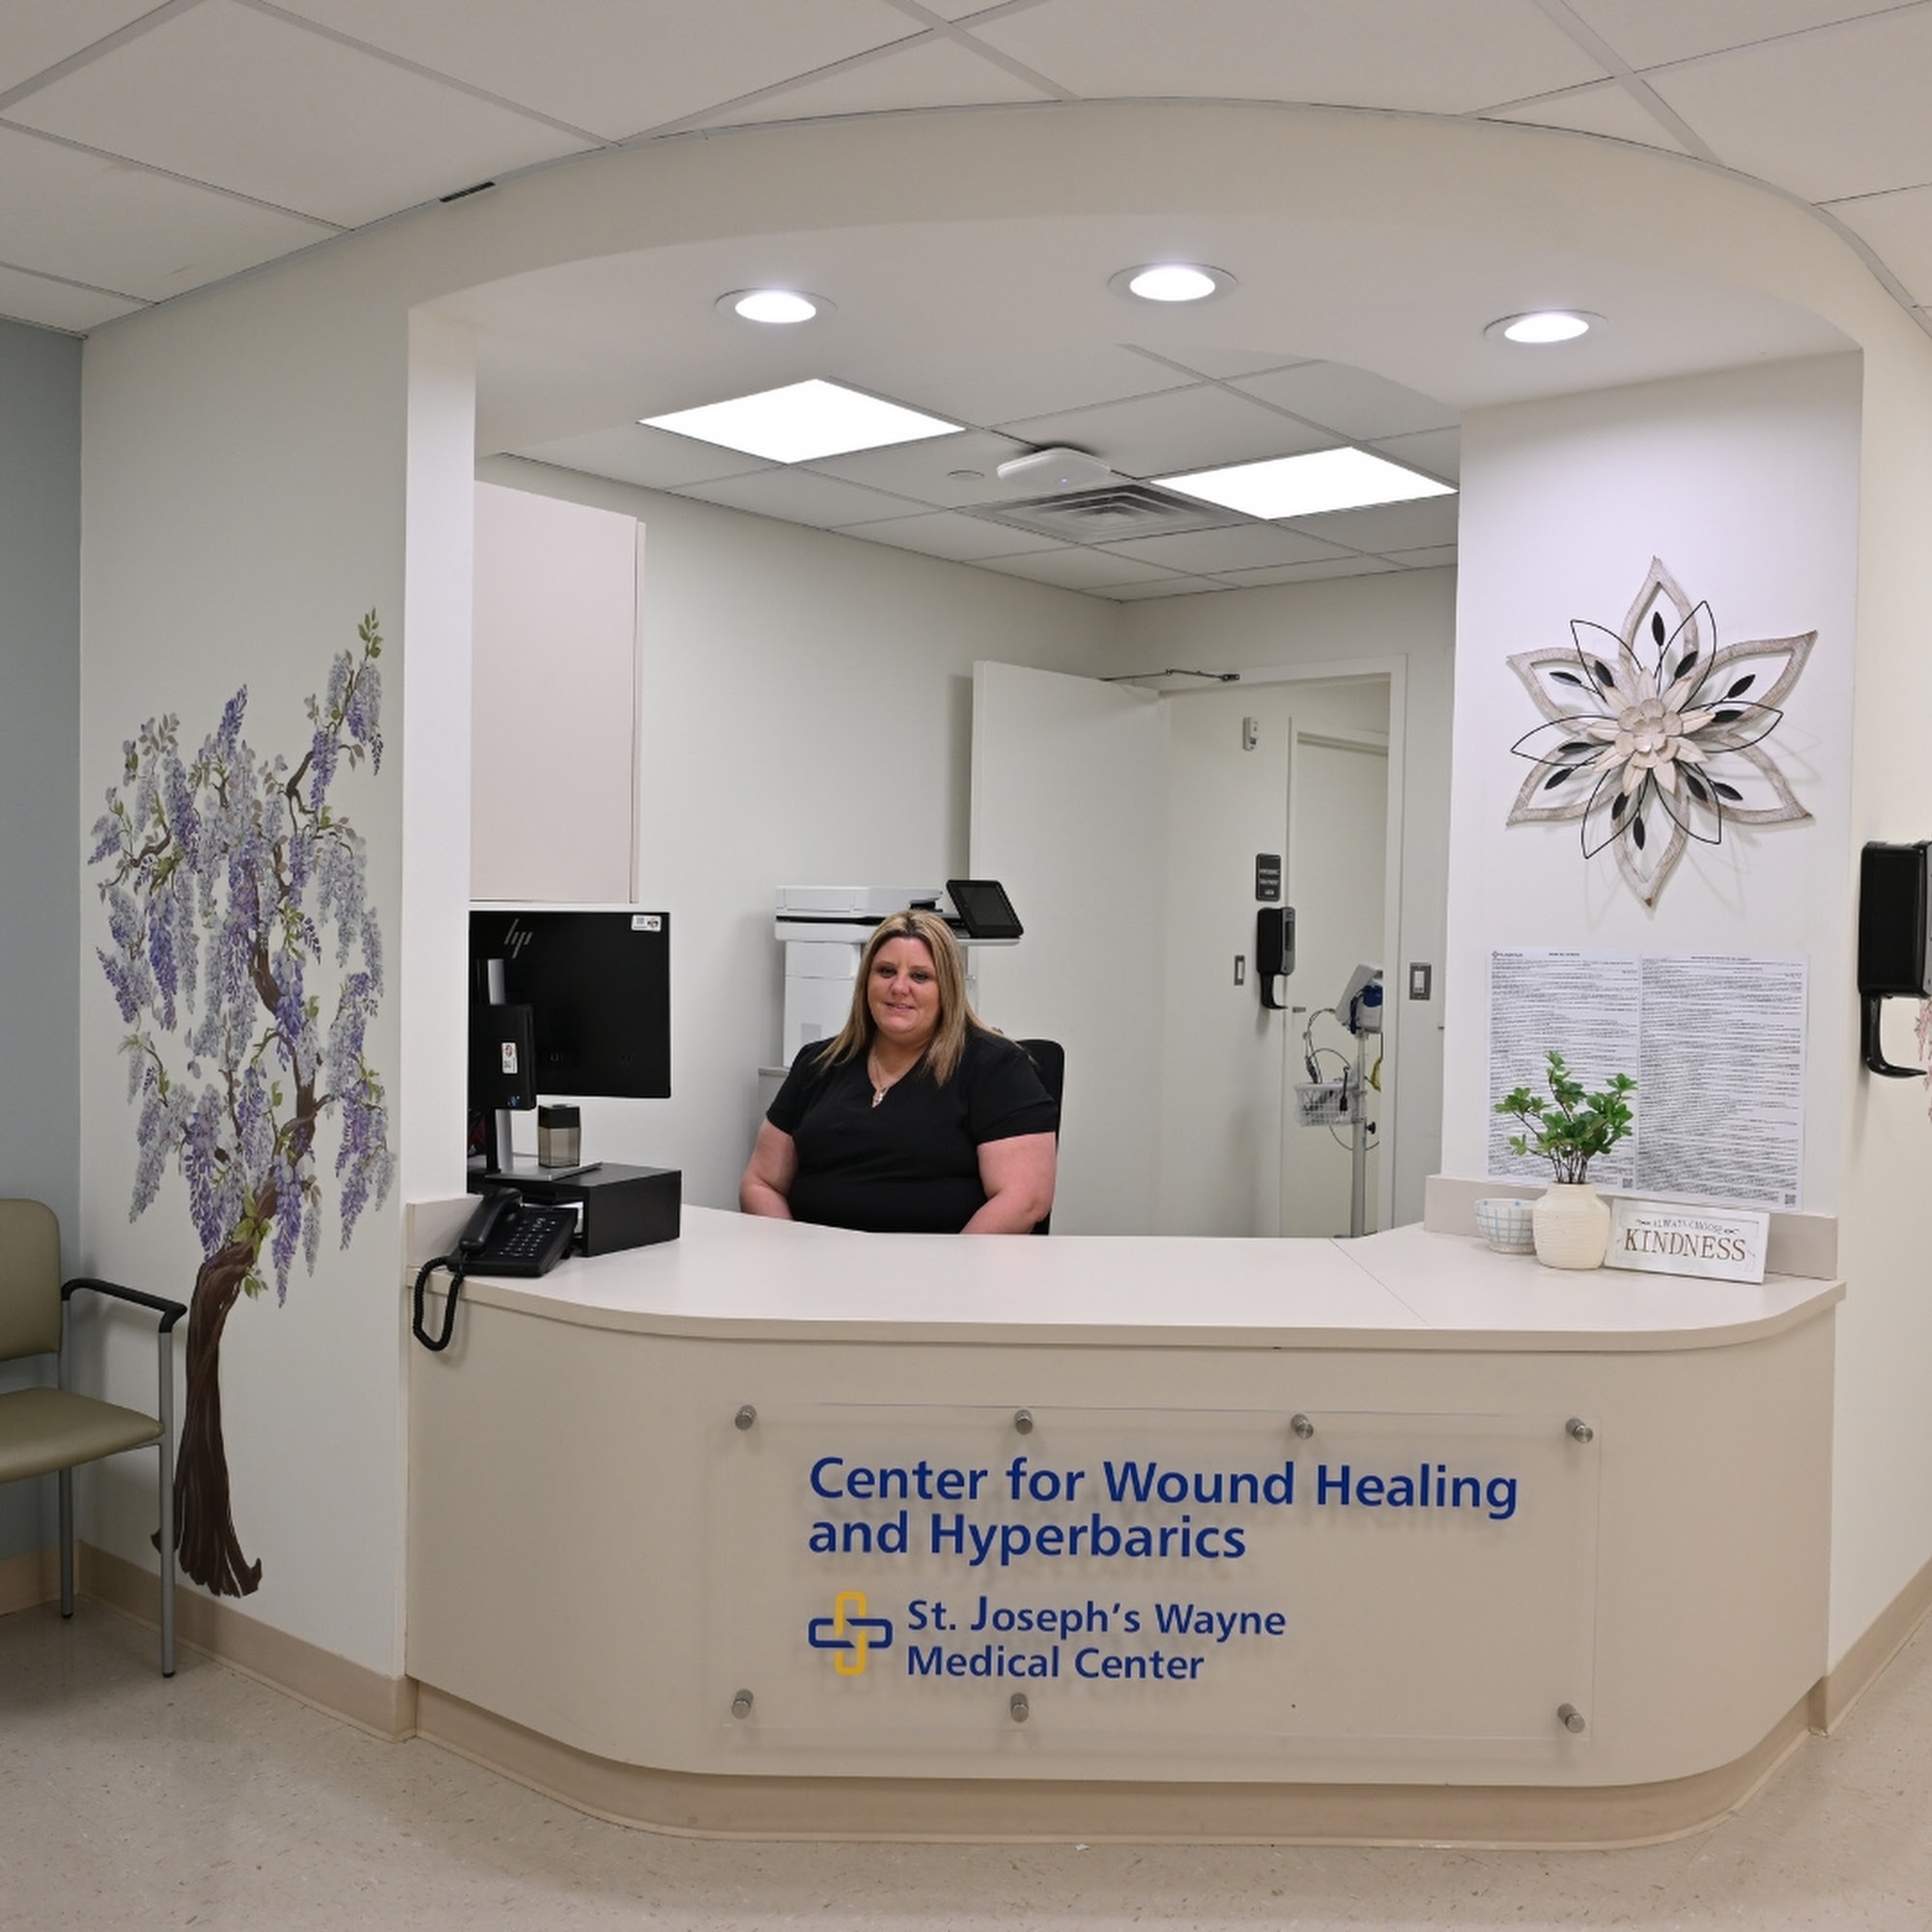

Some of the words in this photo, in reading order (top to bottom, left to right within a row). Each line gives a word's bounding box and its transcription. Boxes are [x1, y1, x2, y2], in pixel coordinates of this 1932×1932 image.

[1624, 1228, 1747, 1263] KINDNESS
[810, 1456, 988, 1501] Center
[1006, 1456, 1087, 1502] for
[1103, 1461, 1294, 1505] Wound
[1317, 1463, 1519, 1520] Healing
[809, 1510, 910, 1554] and
[931, 1513, 1247, 1567] Hyperbarics
[907, 1599, 956, 1632] St.
[971, 1596, 1141, 1640] Joseph's
[1155, 1604, 1287, 1643] Wayne
[907, 1645, 1061, 1679] Medical
[1074, 1647, 1204, 1680] Center
